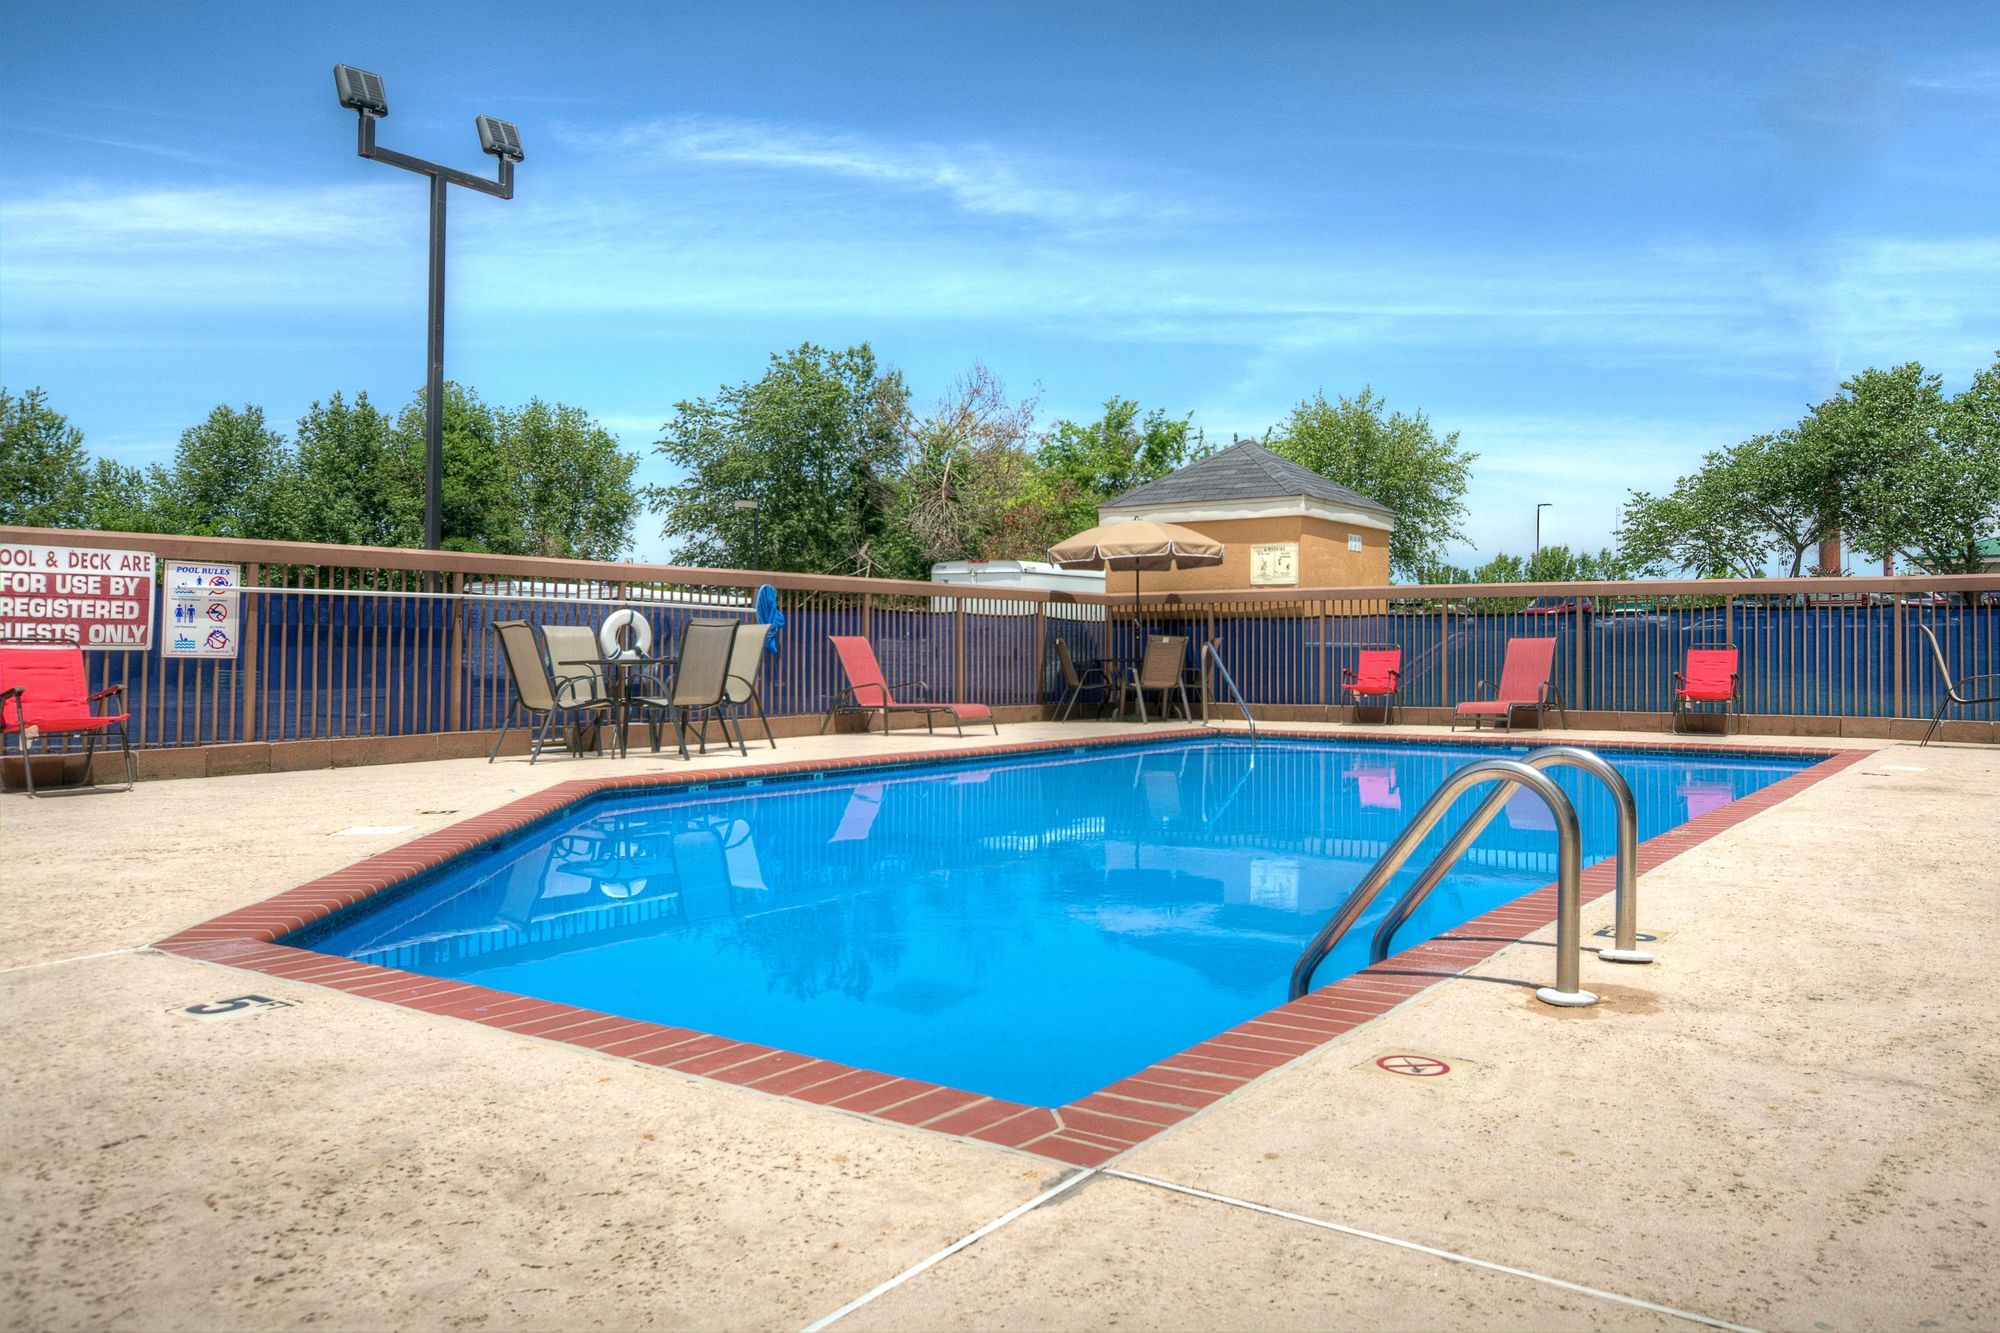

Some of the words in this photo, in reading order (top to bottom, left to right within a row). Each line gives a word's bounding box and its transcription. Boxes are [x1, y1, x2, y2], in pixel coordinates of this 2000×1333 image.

[46, 551, 58, 568] &
[69, 552, 111, 570] DECK
[120, 555, 151, 572] ARE
[176, 566, 200, 574] POOL
[201, 567, 231, 575] RULES
[0, 572, 47, 593] FOR
[55, 574, 101, 595] USE
[109, 576, 140, 596] BY
[0, 597, 139, 620] REGISTERED
[0, 622, 80, 643] UESTS
[88, 623, 147, 643] ONLY
